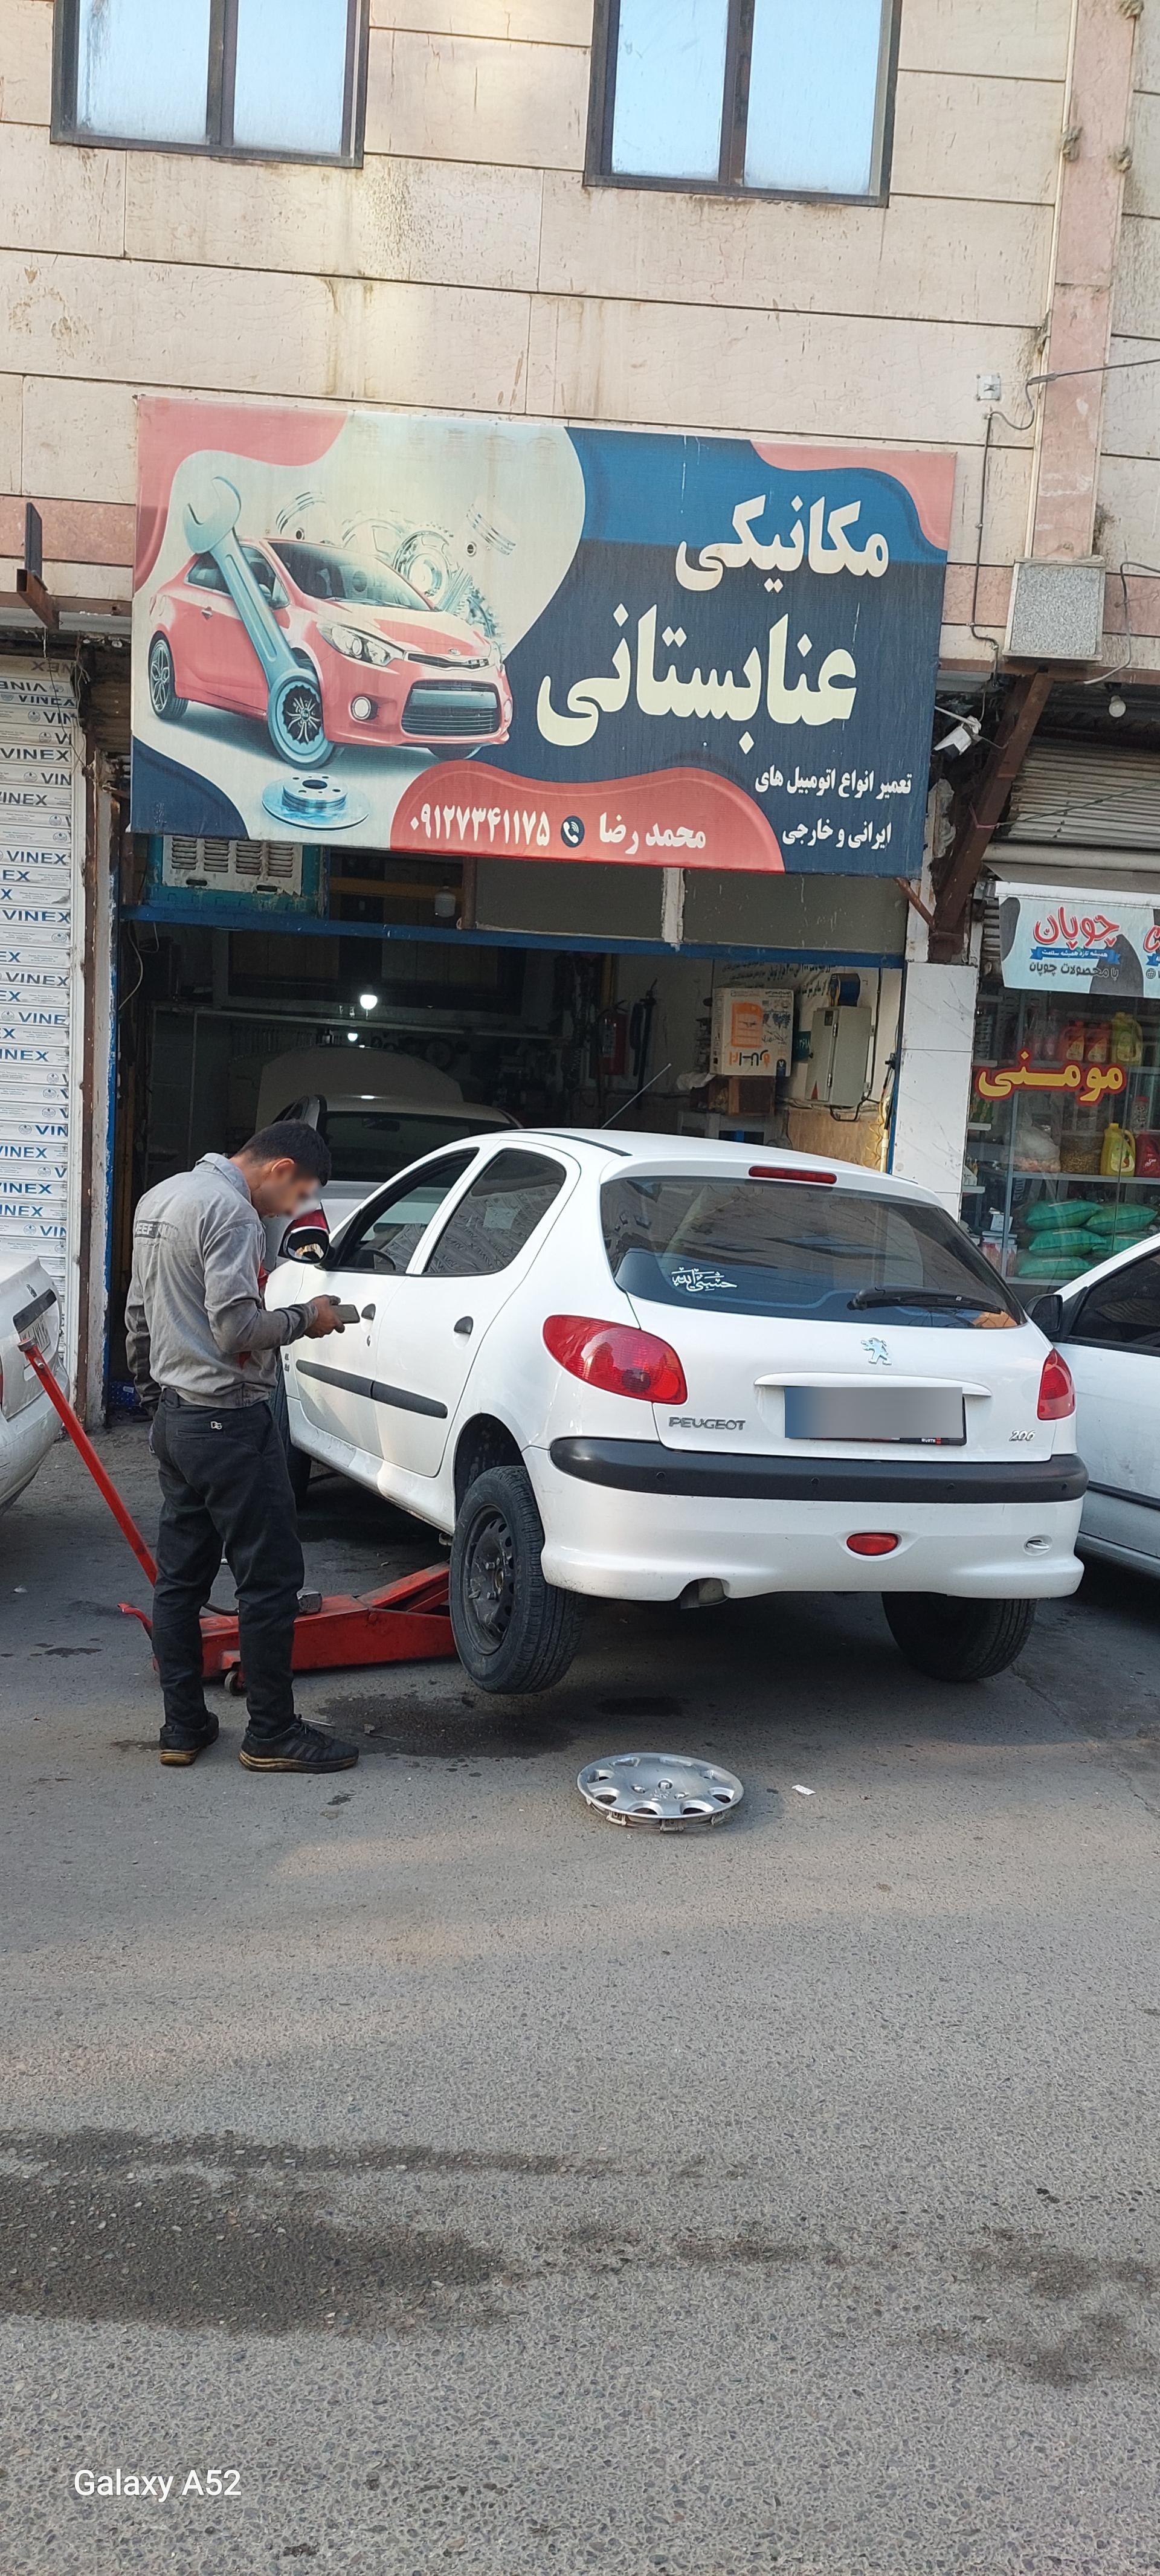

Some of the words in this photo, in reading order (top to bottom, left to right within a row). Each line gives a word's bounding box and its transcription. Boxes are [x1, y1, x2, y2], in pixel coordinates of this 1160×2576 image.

[675, 494, 889, 593] مکانیکی
[536, 603, 857, 755] عنابستانی
[0, 747, 69, 762] VINEX
[755, 764, 784, 793] های
[787, 766, 837, 796] اتومبیل
[838, 769, 874, 798] انواع
[875, 773, 913, 799] تعمیر
[0, 791, 48, 806] INEX
[599, 812, 639, 855] رضا
[646, 822, 706, 849] محمد
[782, 817, 834, 846] خارجی
[835, 828, 845, 848] و
[848, 820, 892, 850] ایرانی
[7, 850, 67, 865] VINEX
[2, 909, 71, 924] VINEX
[1033, 906, 1120, 950] چوپان
[5, 971, 69, 987] VINEX
[1029, 961, 1057, 977] چوپان
[1060, 962, 1110, 978] محصولات
[978, 1051, 1124, 1102] مومنی
[669, 1417, 747, 1431] PEUGEOT
[1008, 1429, 1037, 1442] 206
